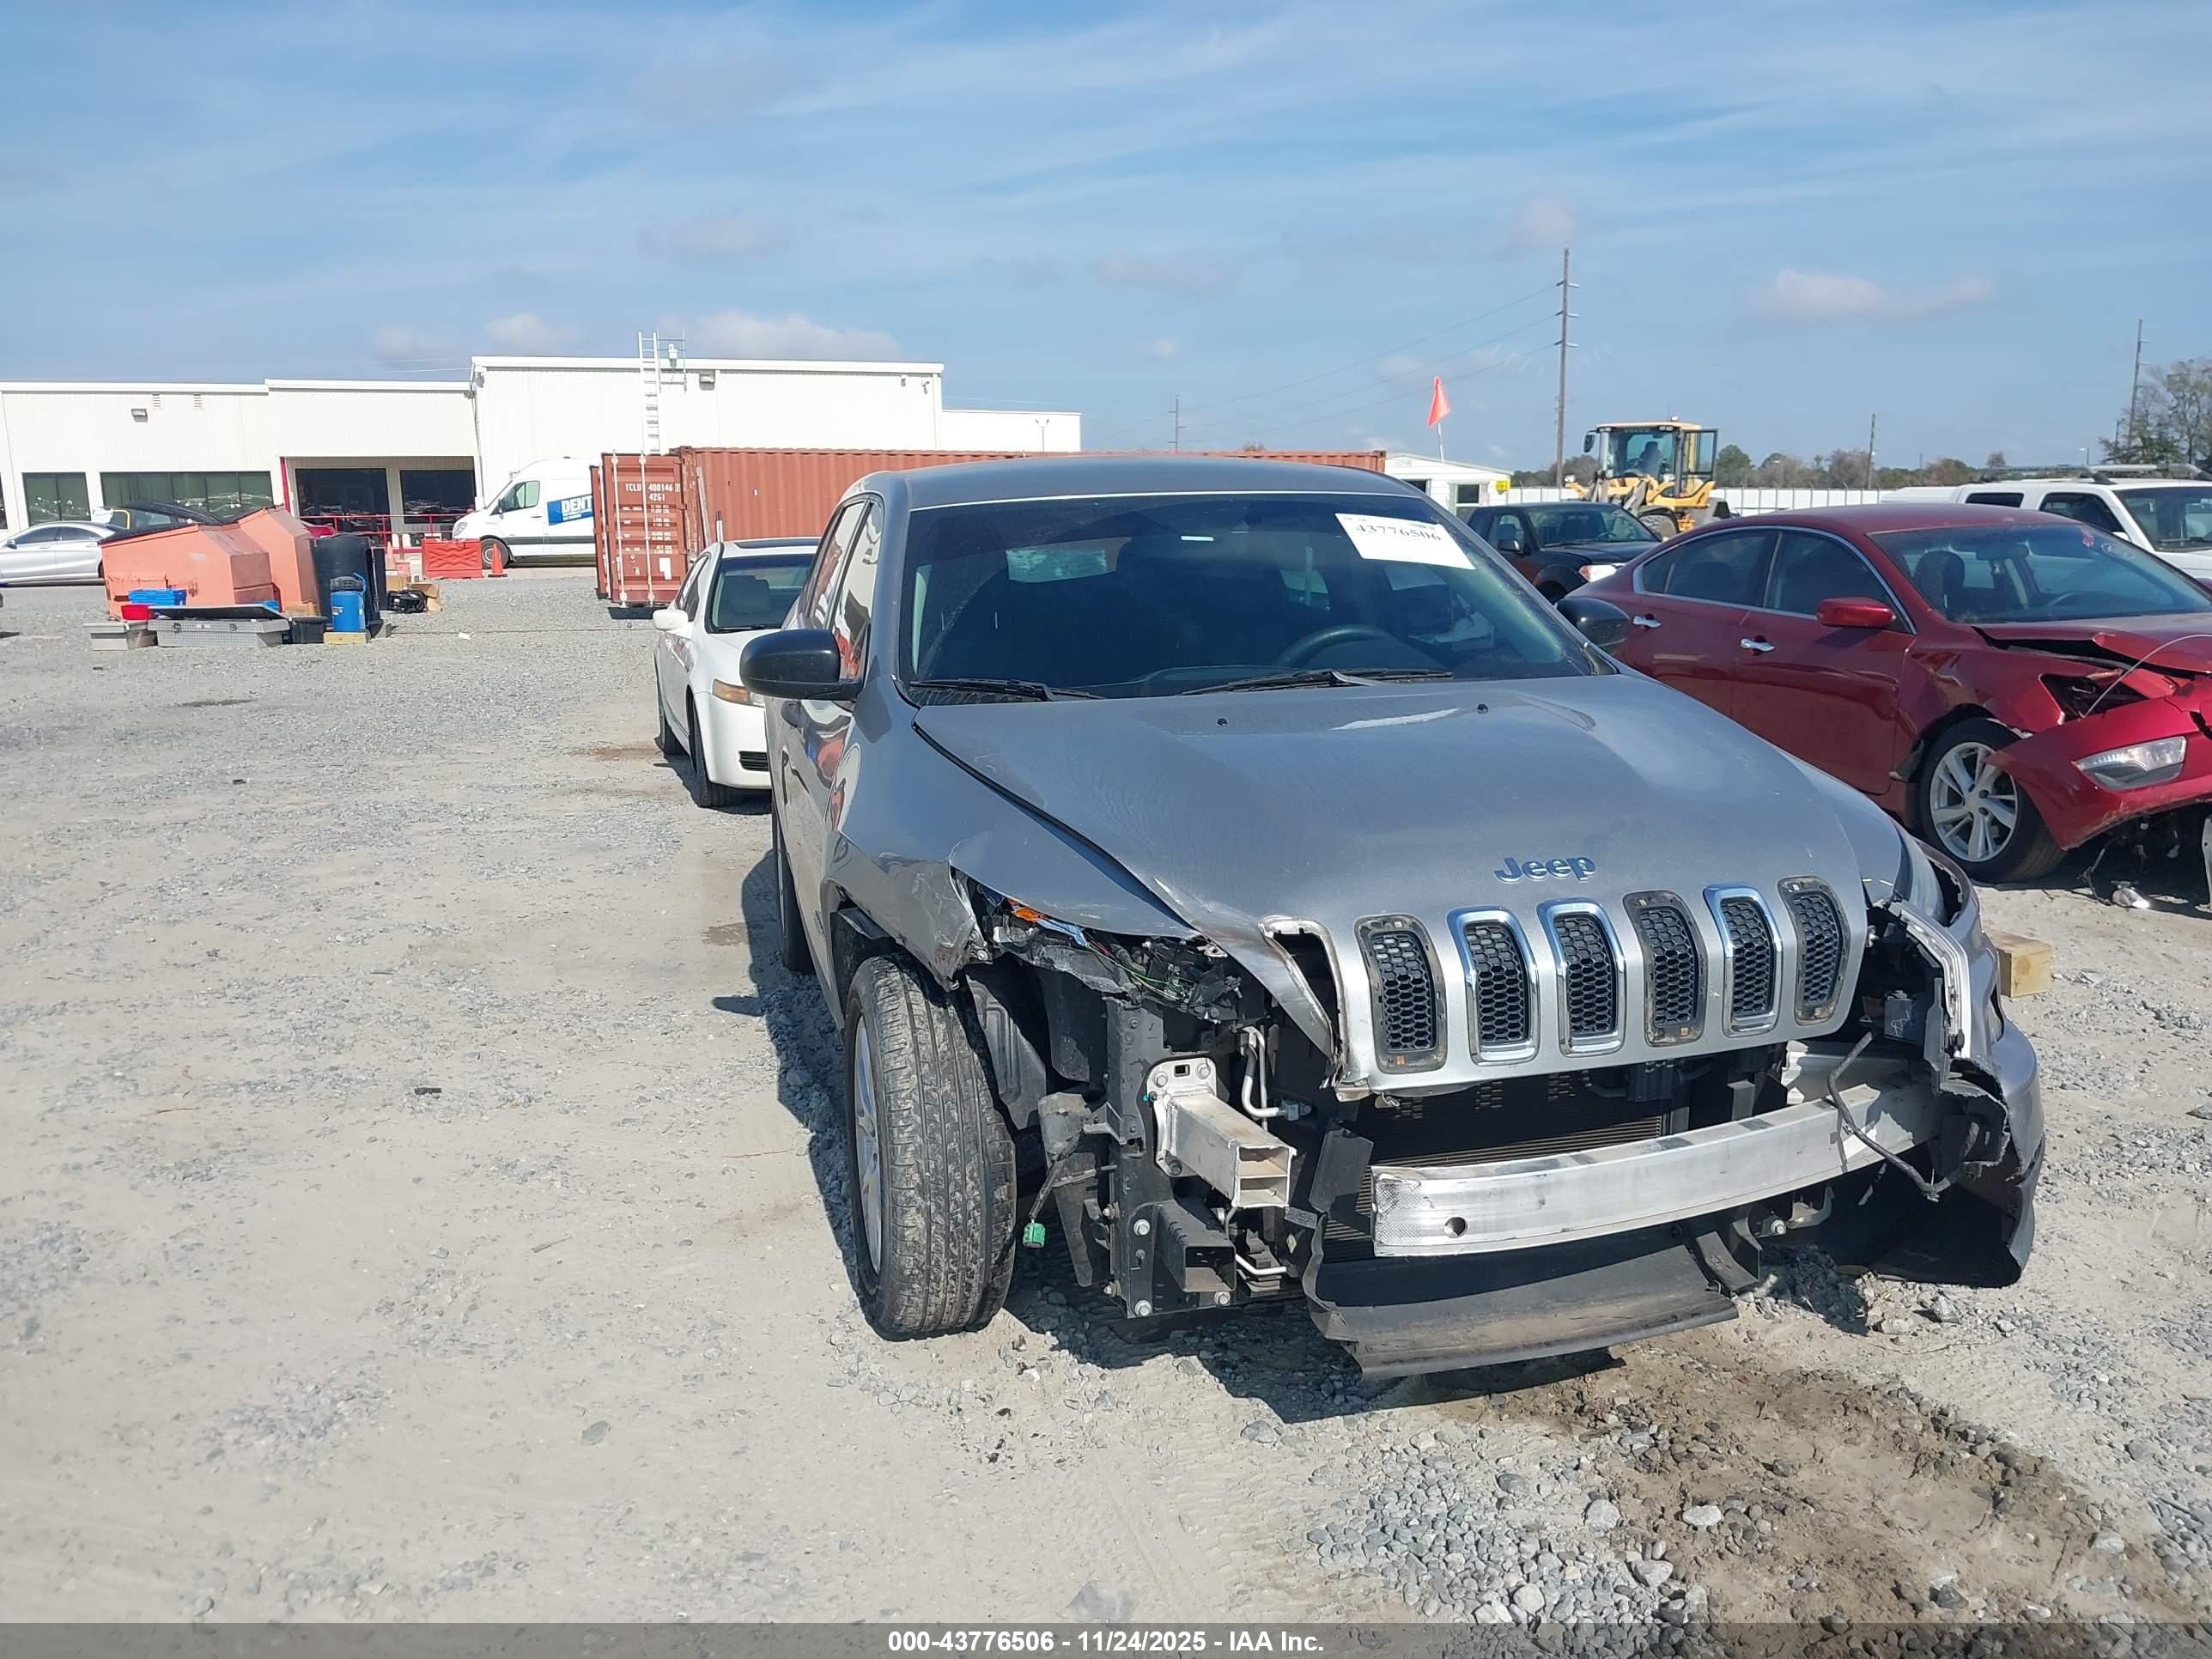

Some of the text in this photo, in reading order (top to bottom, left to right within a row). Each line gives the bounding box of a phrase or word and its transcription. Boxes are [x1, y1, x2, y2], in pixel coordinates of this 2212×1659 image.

[649, 493, 665, 501] 42G1
[1356, 524, 1442, 541] 43776506
[1493, 856, 1596, 884] Jeep
